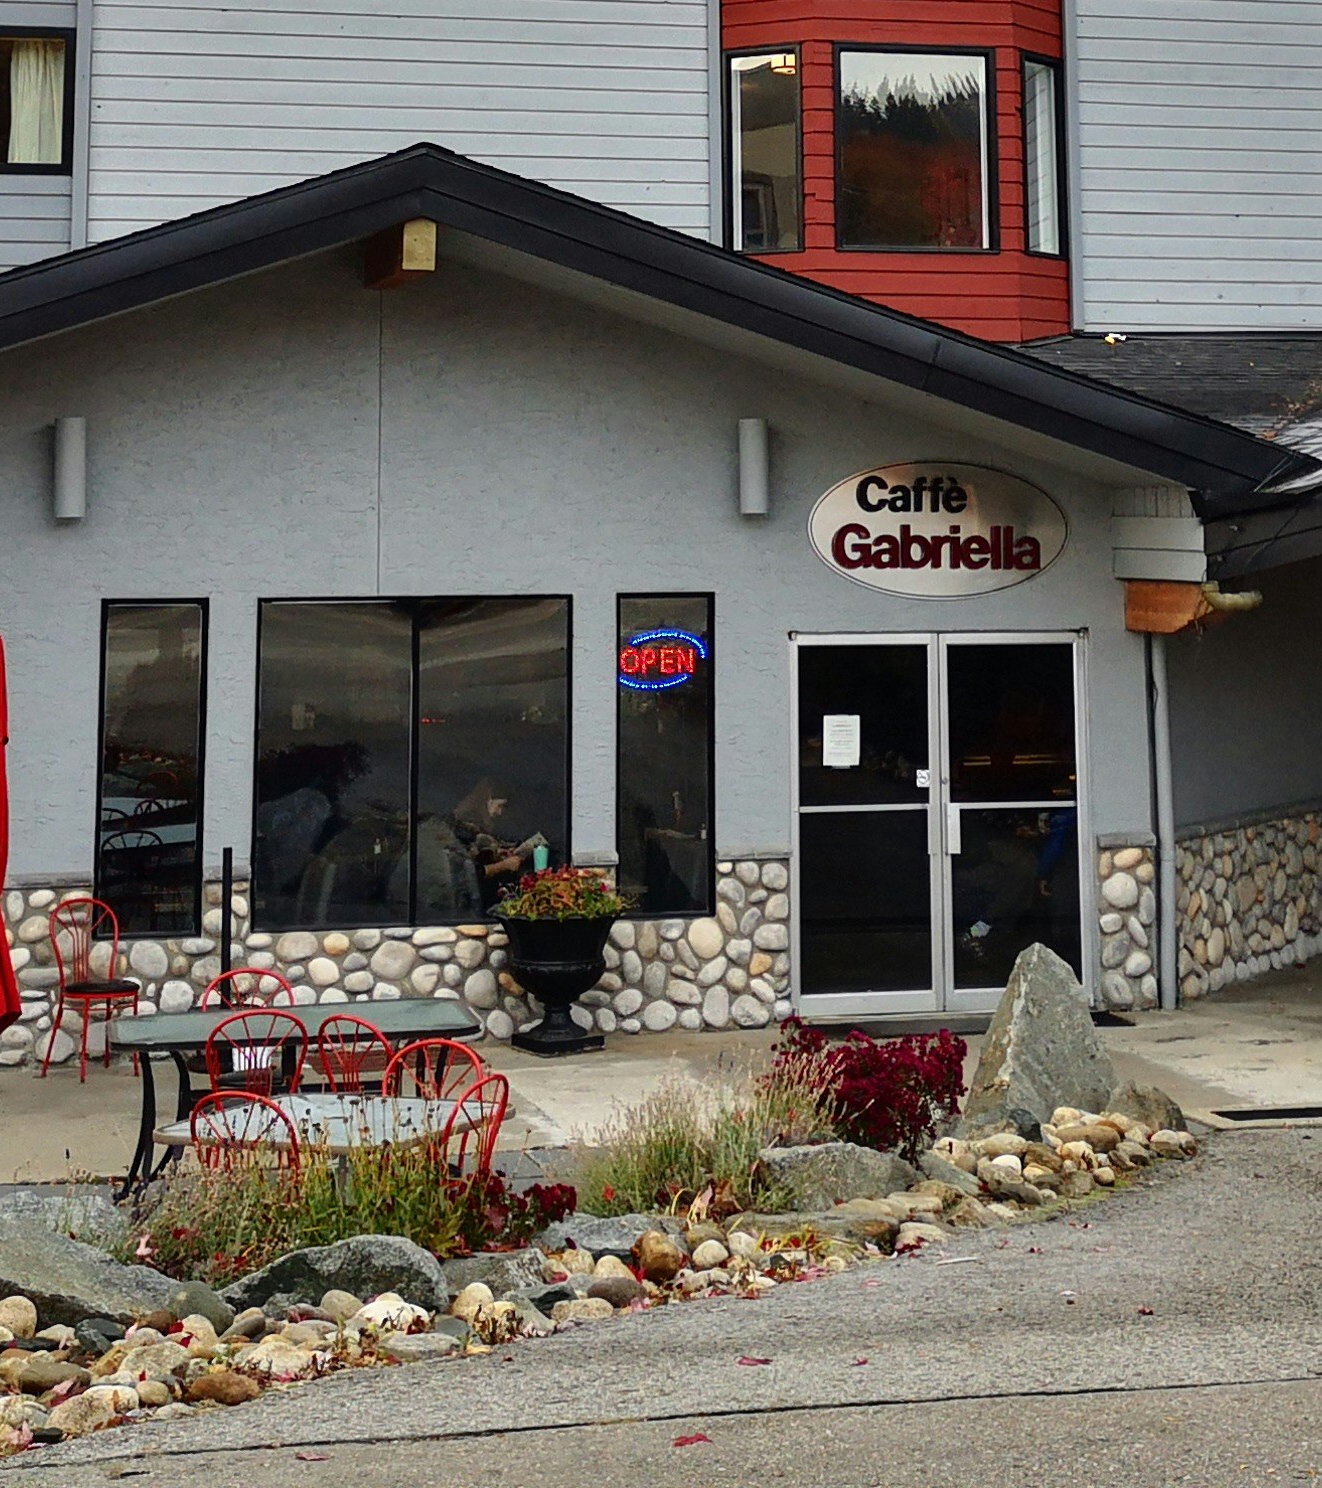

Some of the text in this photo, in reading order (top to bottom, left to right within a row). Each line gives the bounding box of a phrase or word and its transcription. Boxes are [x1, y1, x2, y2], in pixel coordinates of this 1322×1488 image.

[855, 476, 968, 514] Caffè
[831, 522, 1042, 571] Gabriella
[620, 647, 695, 674] OPEN
